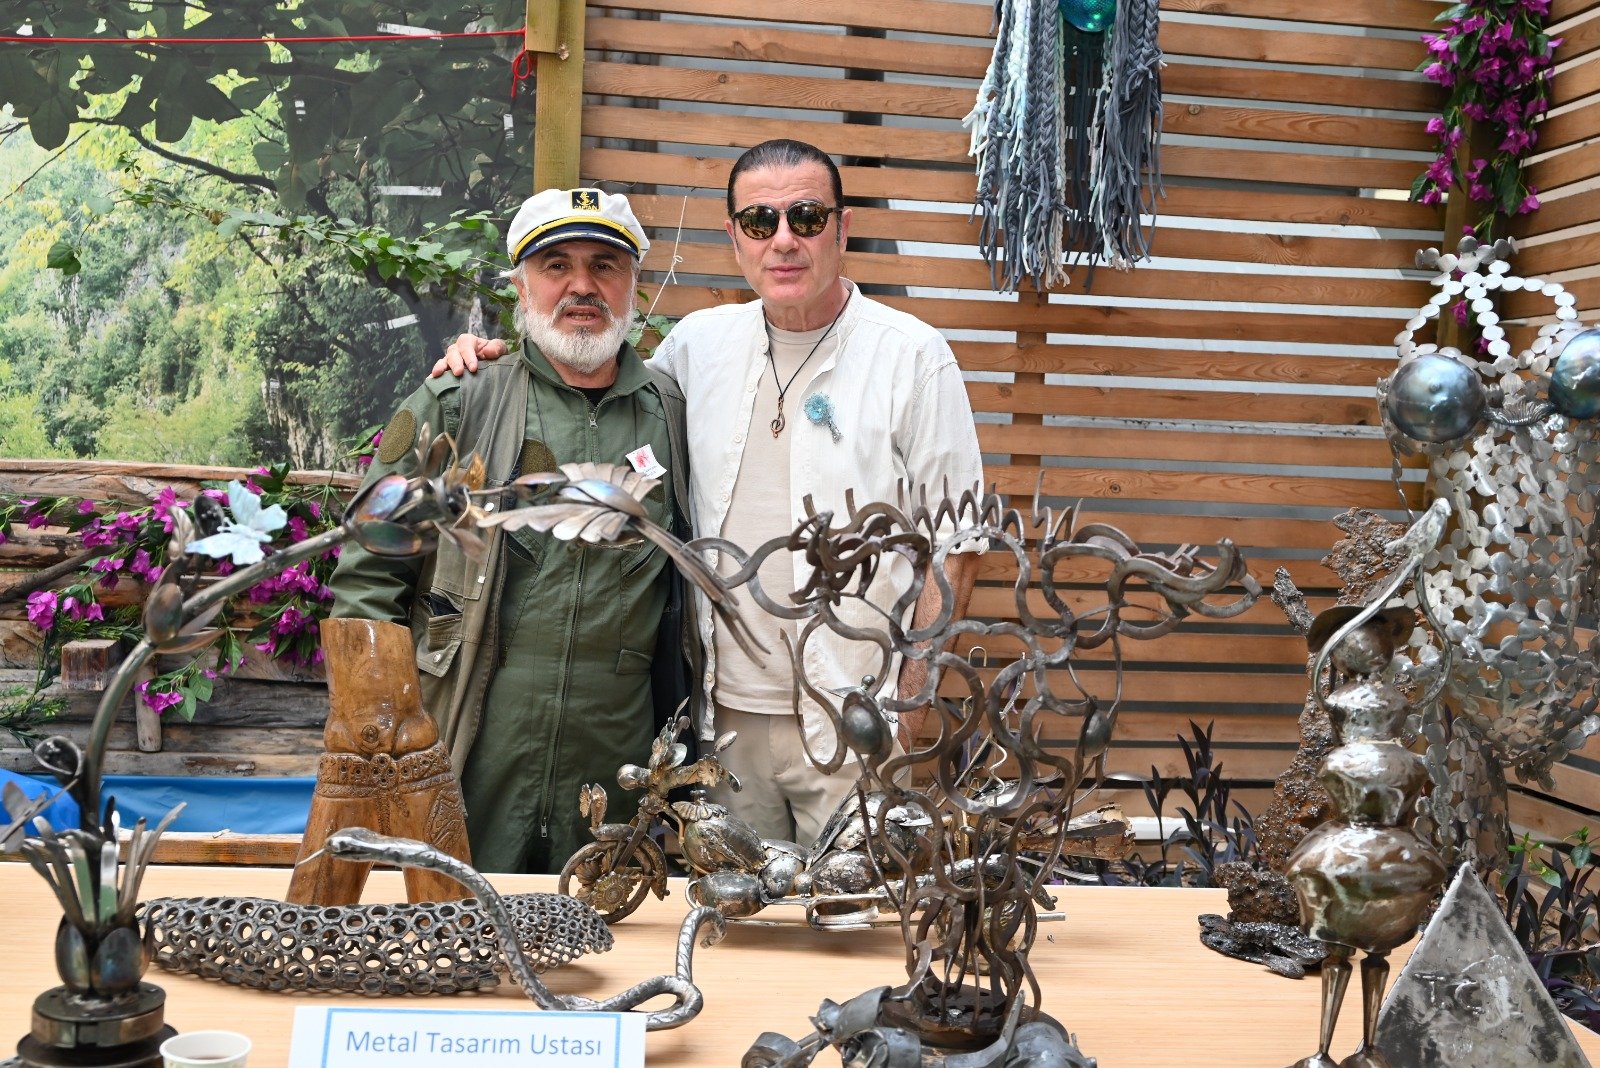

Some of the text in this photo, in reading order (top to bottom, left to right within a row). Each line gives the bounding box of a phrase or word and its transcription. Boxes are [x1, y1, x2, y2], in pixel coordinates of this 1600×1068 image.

[346, 1030, 601, 1056] Metal Tasarım Ustası
